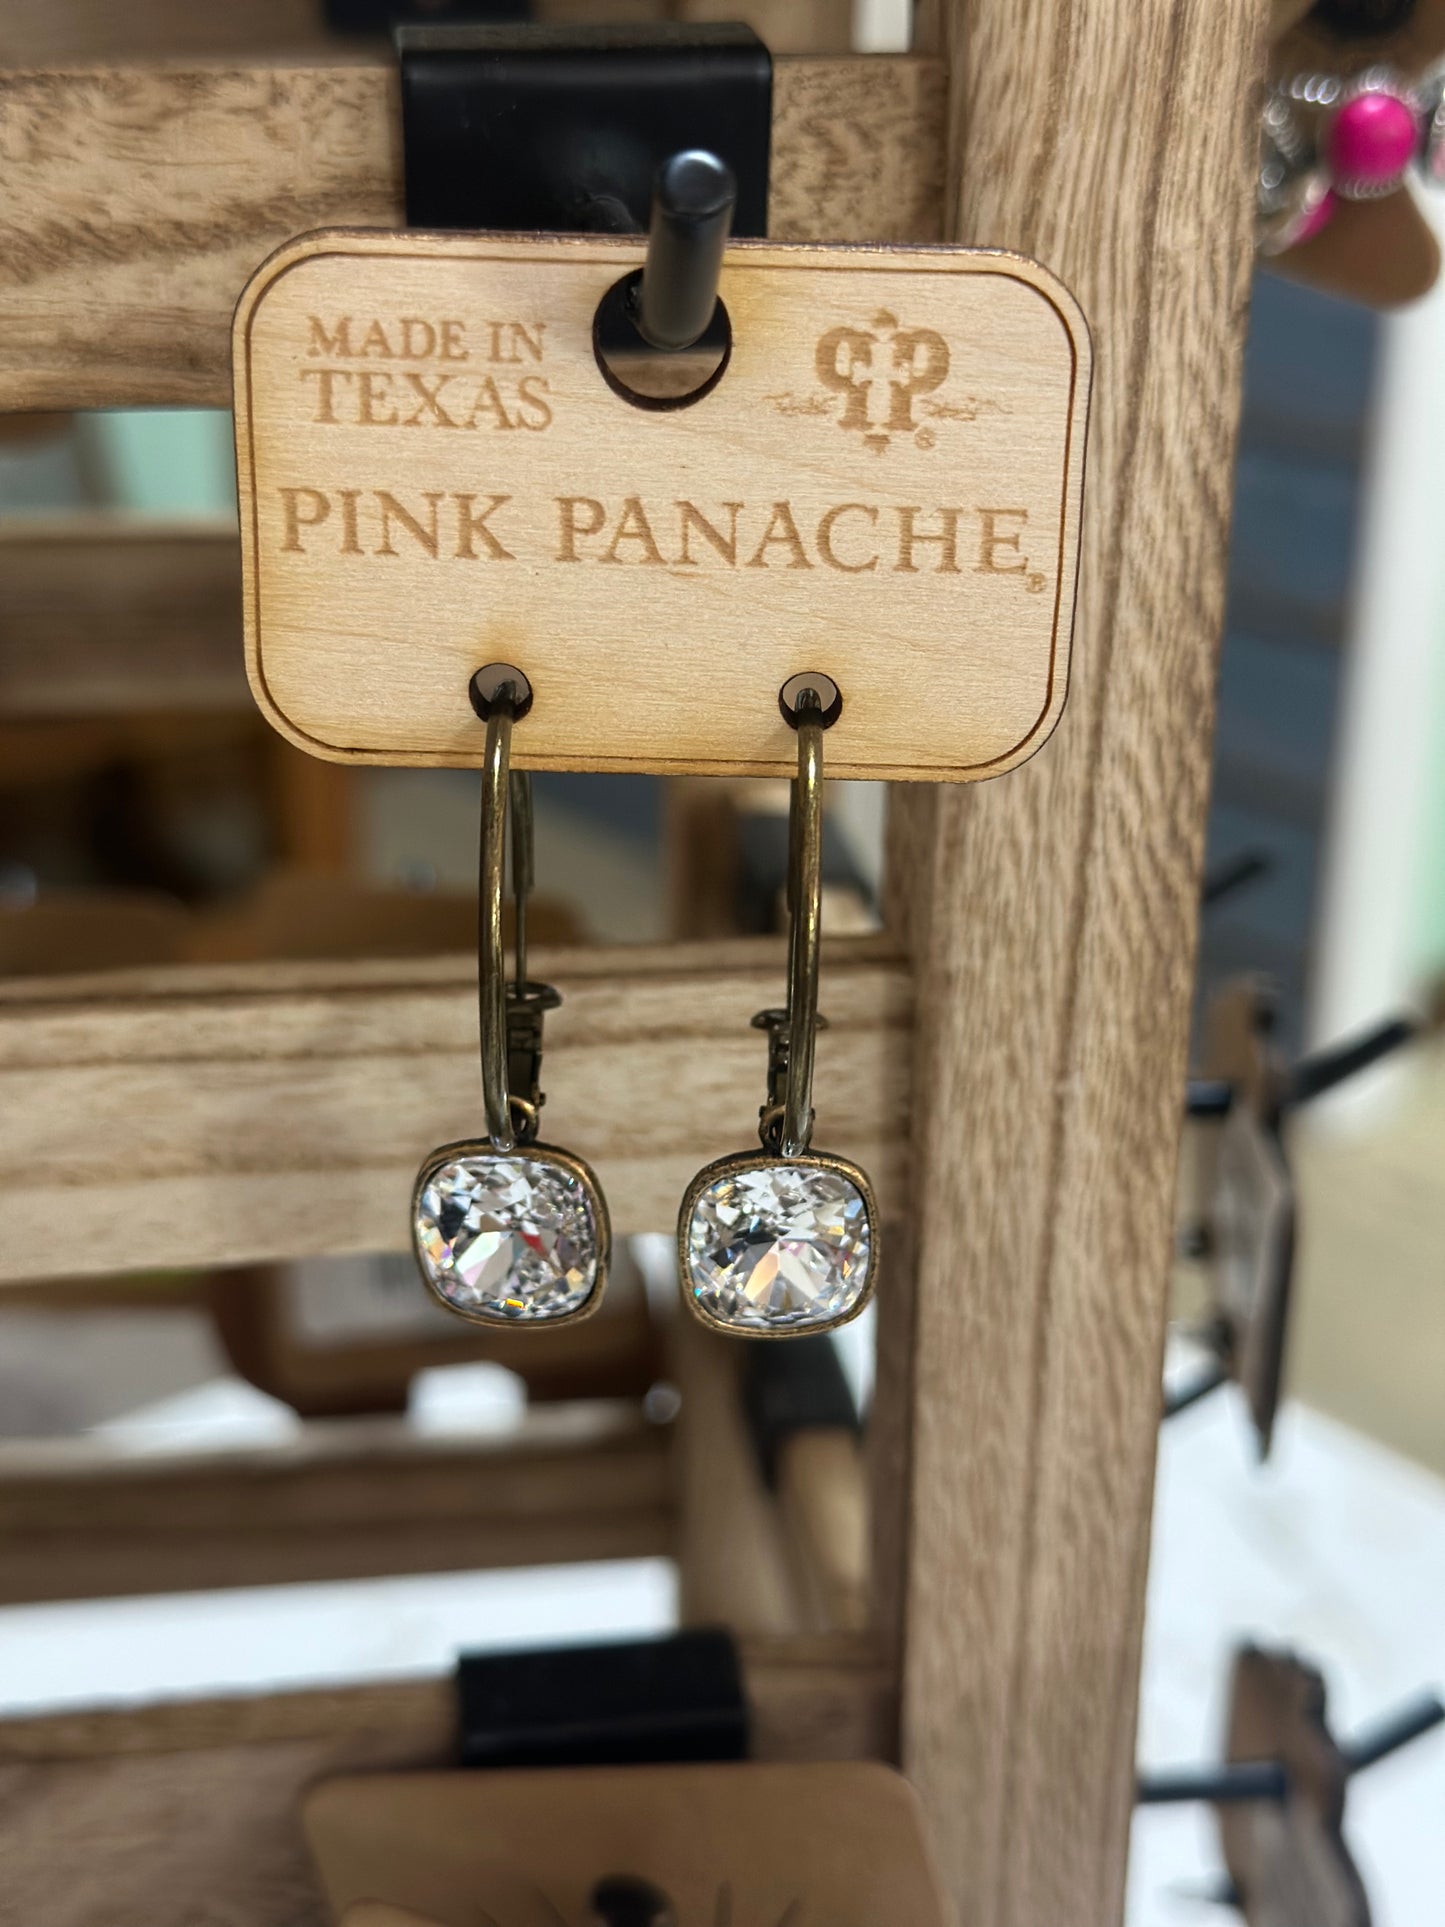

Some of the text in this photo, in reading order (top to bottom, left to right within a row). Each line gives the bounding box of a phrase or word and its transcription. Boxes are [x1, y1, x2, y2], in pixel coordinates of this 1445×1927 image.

[307, 315, 547, 363] MADE IN
[299, 369, 552, 431] TEXAS
[277, 487, 517, 560] PINK
